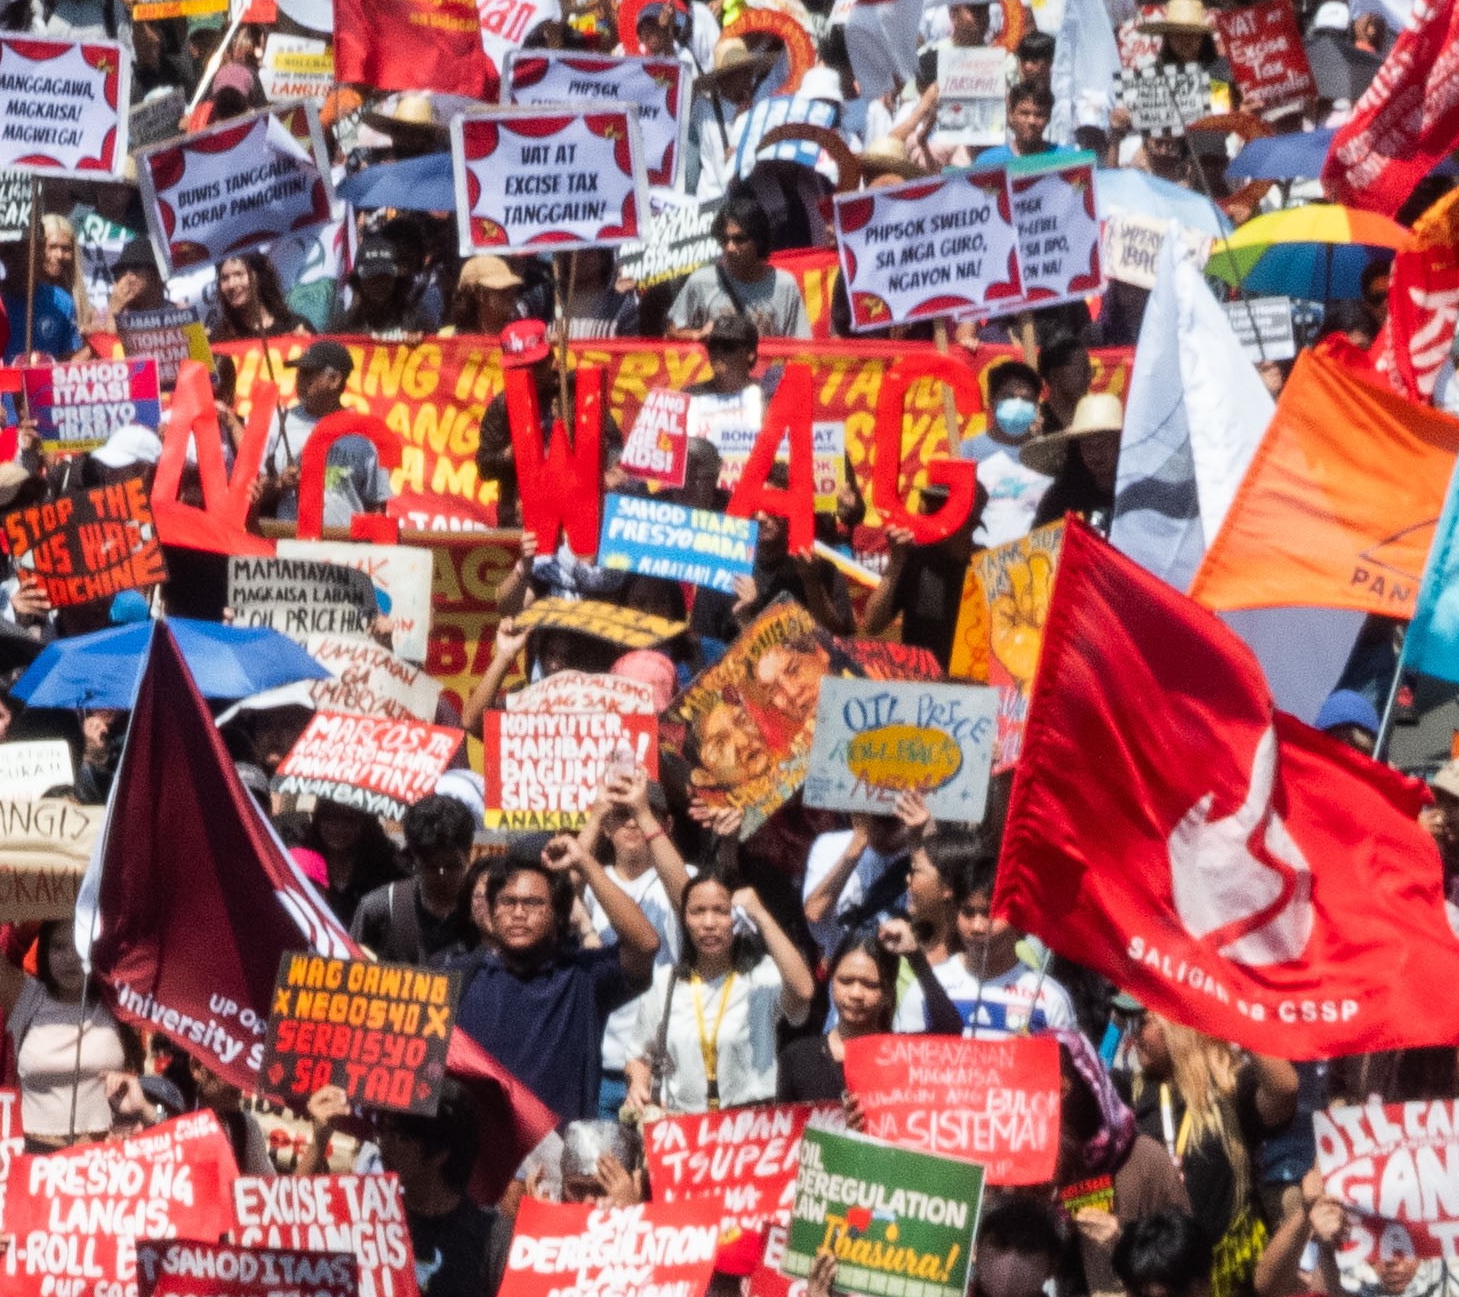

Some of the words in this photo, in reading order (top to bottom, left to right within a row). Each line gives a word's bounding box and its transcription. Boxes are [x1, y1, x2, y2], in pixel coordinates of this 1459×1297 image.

[6, 98, 82, 123] MAGKAISA!
[520, 145, 550, 166] VAT
[552, 143, 577, 165] AT
[504, 175, 555, 196] EXCISE
[559, 172, 598, 194] TAX
[180, 205, 227, 229] KORAP
[503, 202, 607, 225] TANGGALIN!
[930, 206, 992, 237] SWELDO
[874, 247, 896, 269] SA
[900, 244, 934, 268] MGA
[939, 236, 988, 263] GURO,
[887, 265, 950, 294] NGAYON
[954, 259, 983, 282] NA!
[52, 362, 128, 383] SAHOD
[52, 404, 136, 424] PRESYO
[4, 499, 73, 544] STOP
[87, 481, 147, 516] THE
[287, 959, 344, 987] WAG
[294, 993, 421, 1033] NEGOSYO
[275, 1022, 427, 1070] SERBISYO
[1313, 1102, 1404, 1174] OIL
[27, 1154, 144, 1198] PRESYO
[149, 1164, 193, 1214] NG
[794, 1168, 968, 1228] DEREGULATION
[234, 1176, 333, 1227] EXCISE
[509, 1222, 718, 1274] DEREGULATION
[162, 1247, 259, 1285] SAHOD
